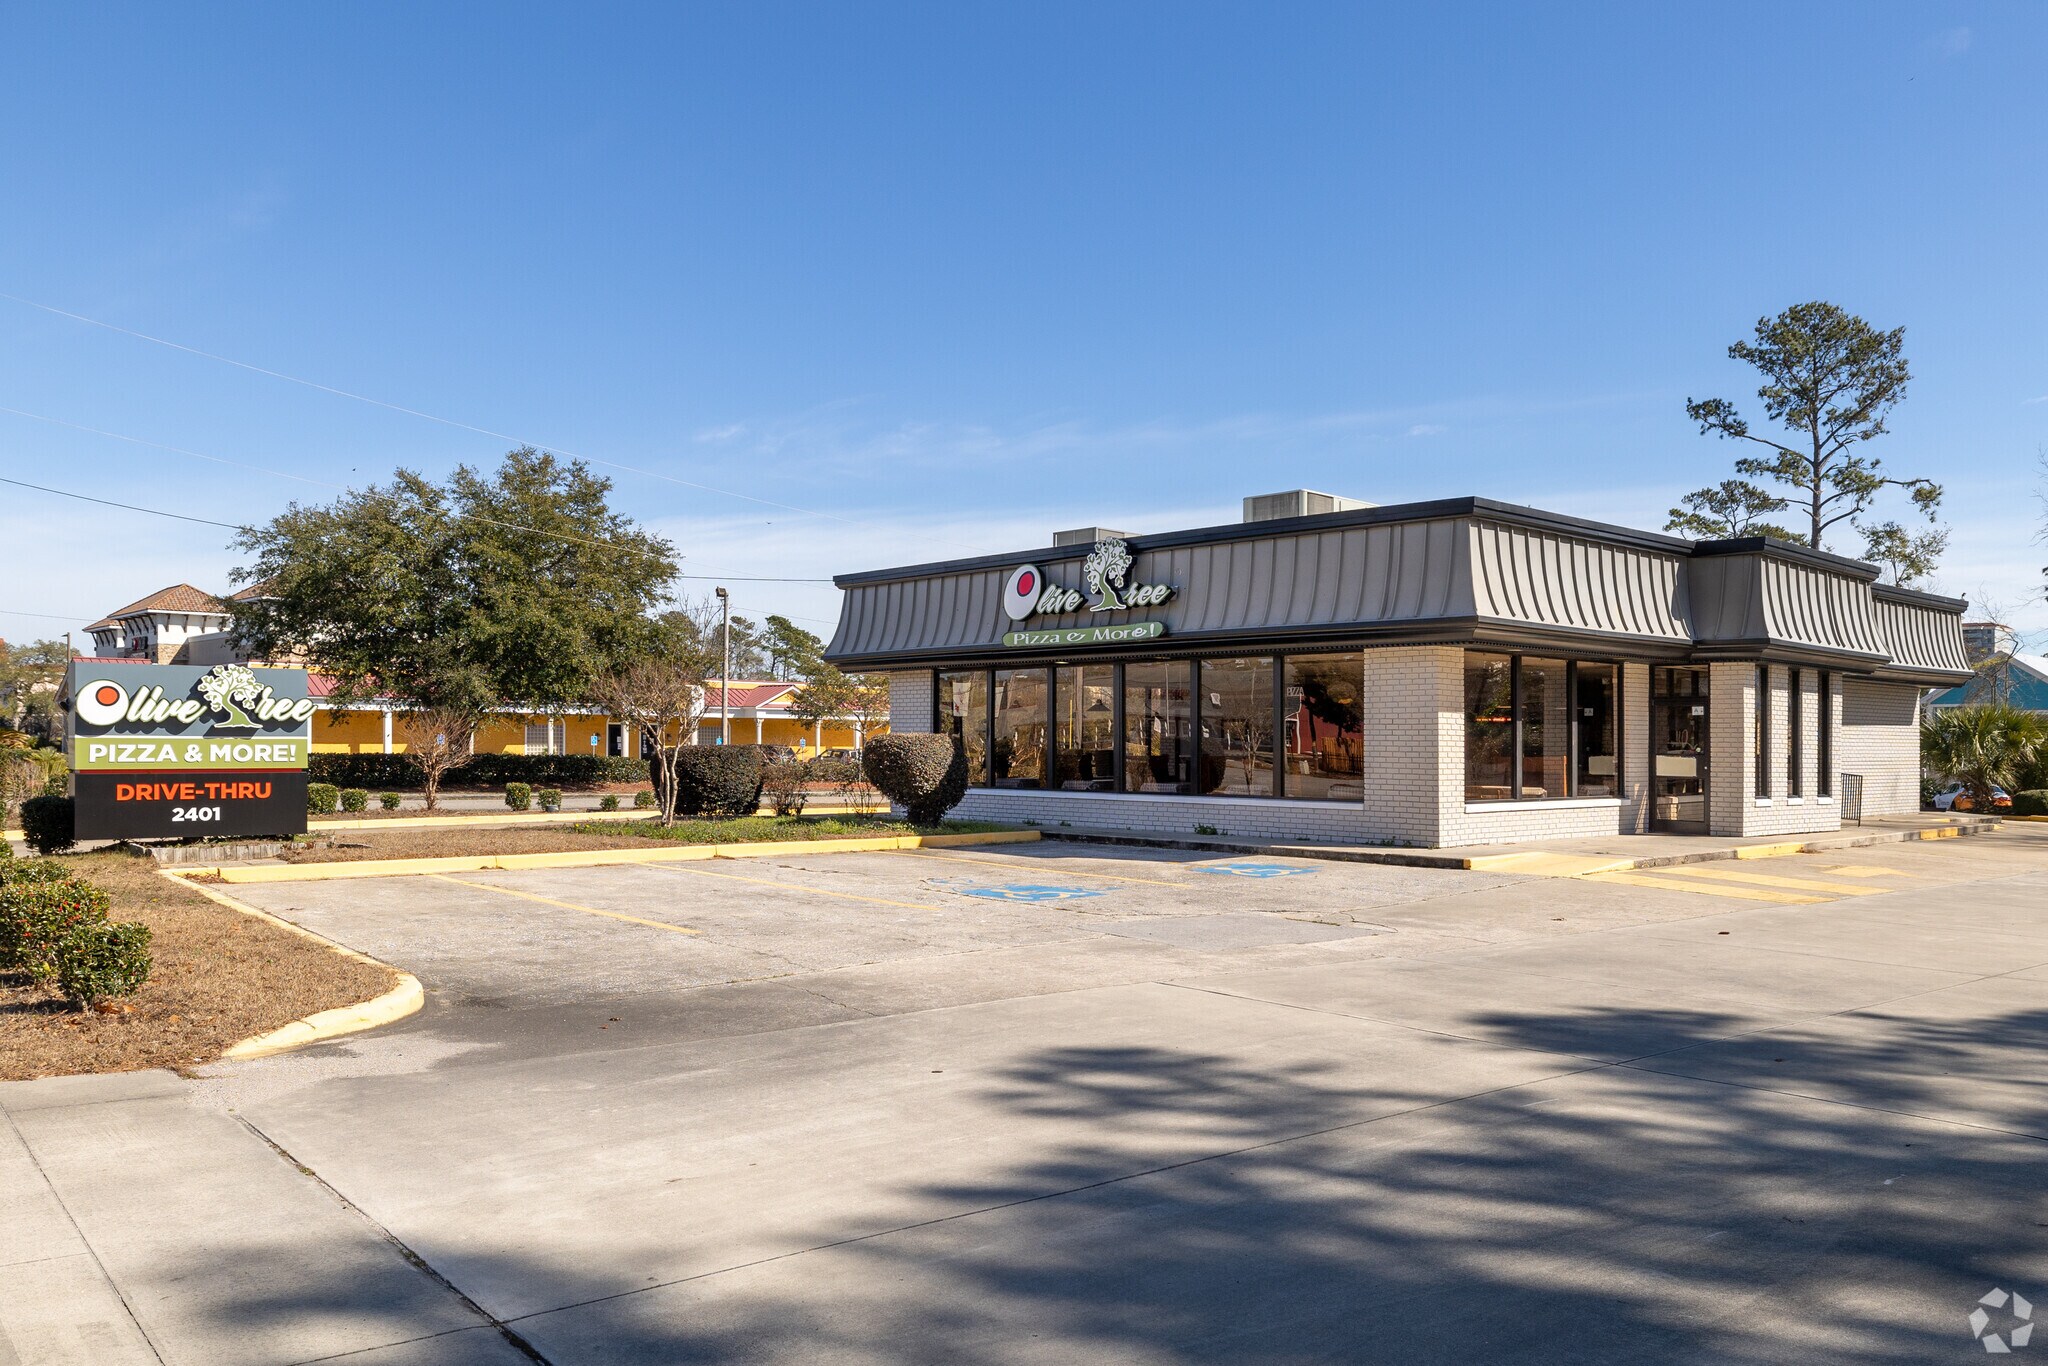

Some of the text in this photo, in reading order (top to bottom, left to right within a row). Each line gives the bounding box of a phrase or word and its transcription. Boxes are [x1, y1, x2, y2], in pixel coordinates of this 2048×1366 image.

[1003, 564, 1084, 621] Olive
[1013, 623, 1155, 645] Pizza & More!
[75, 679, 208, 726] Olive
[88, 743, 297, 763] PIZZA & MORE!
[115, 781, 273, 801] DRIVE-THRU
[171, 806, 221, 822] 2401
